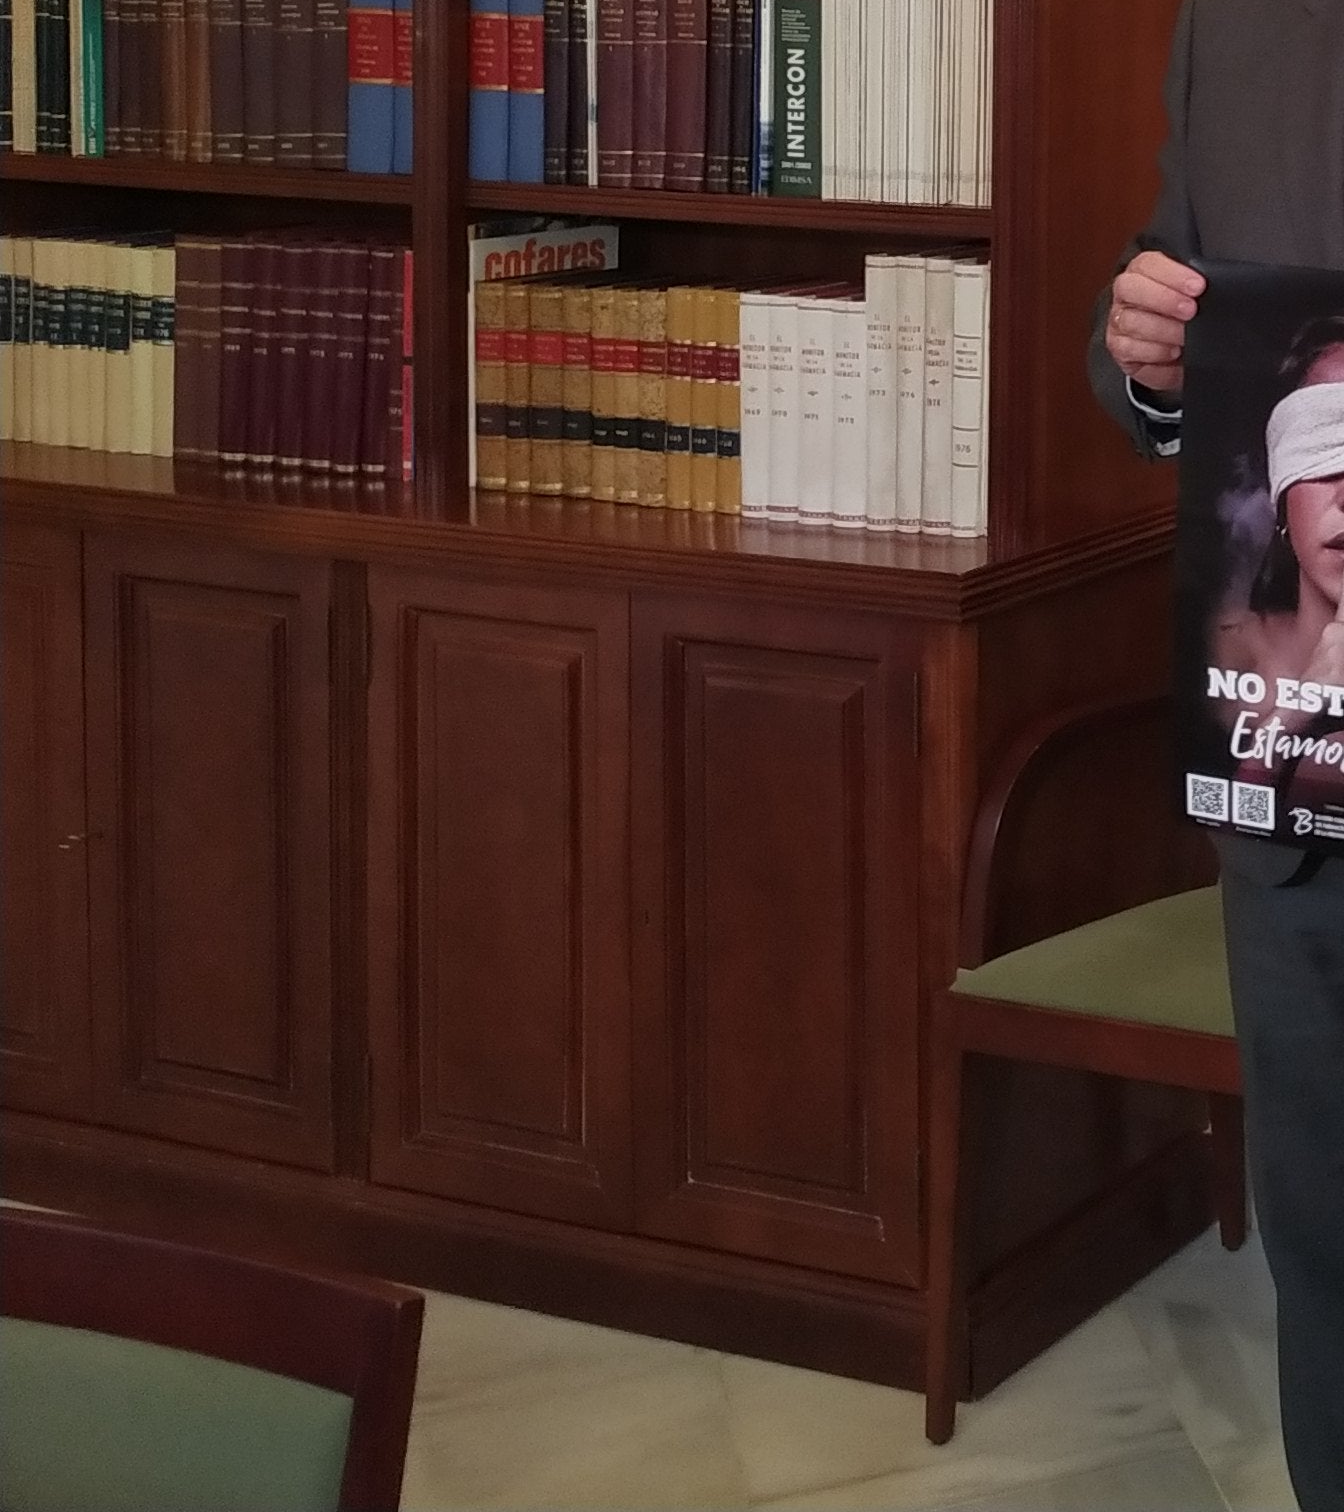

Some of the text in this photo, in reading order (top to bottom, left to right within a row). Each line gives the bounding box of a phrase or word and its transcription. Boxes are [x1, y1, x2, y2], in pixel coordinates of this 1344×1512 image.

[787, 48, 806, 157] INTERCON
[485, 238, 607, 281] cofares
[1206, 667, 1266, 704] NO
